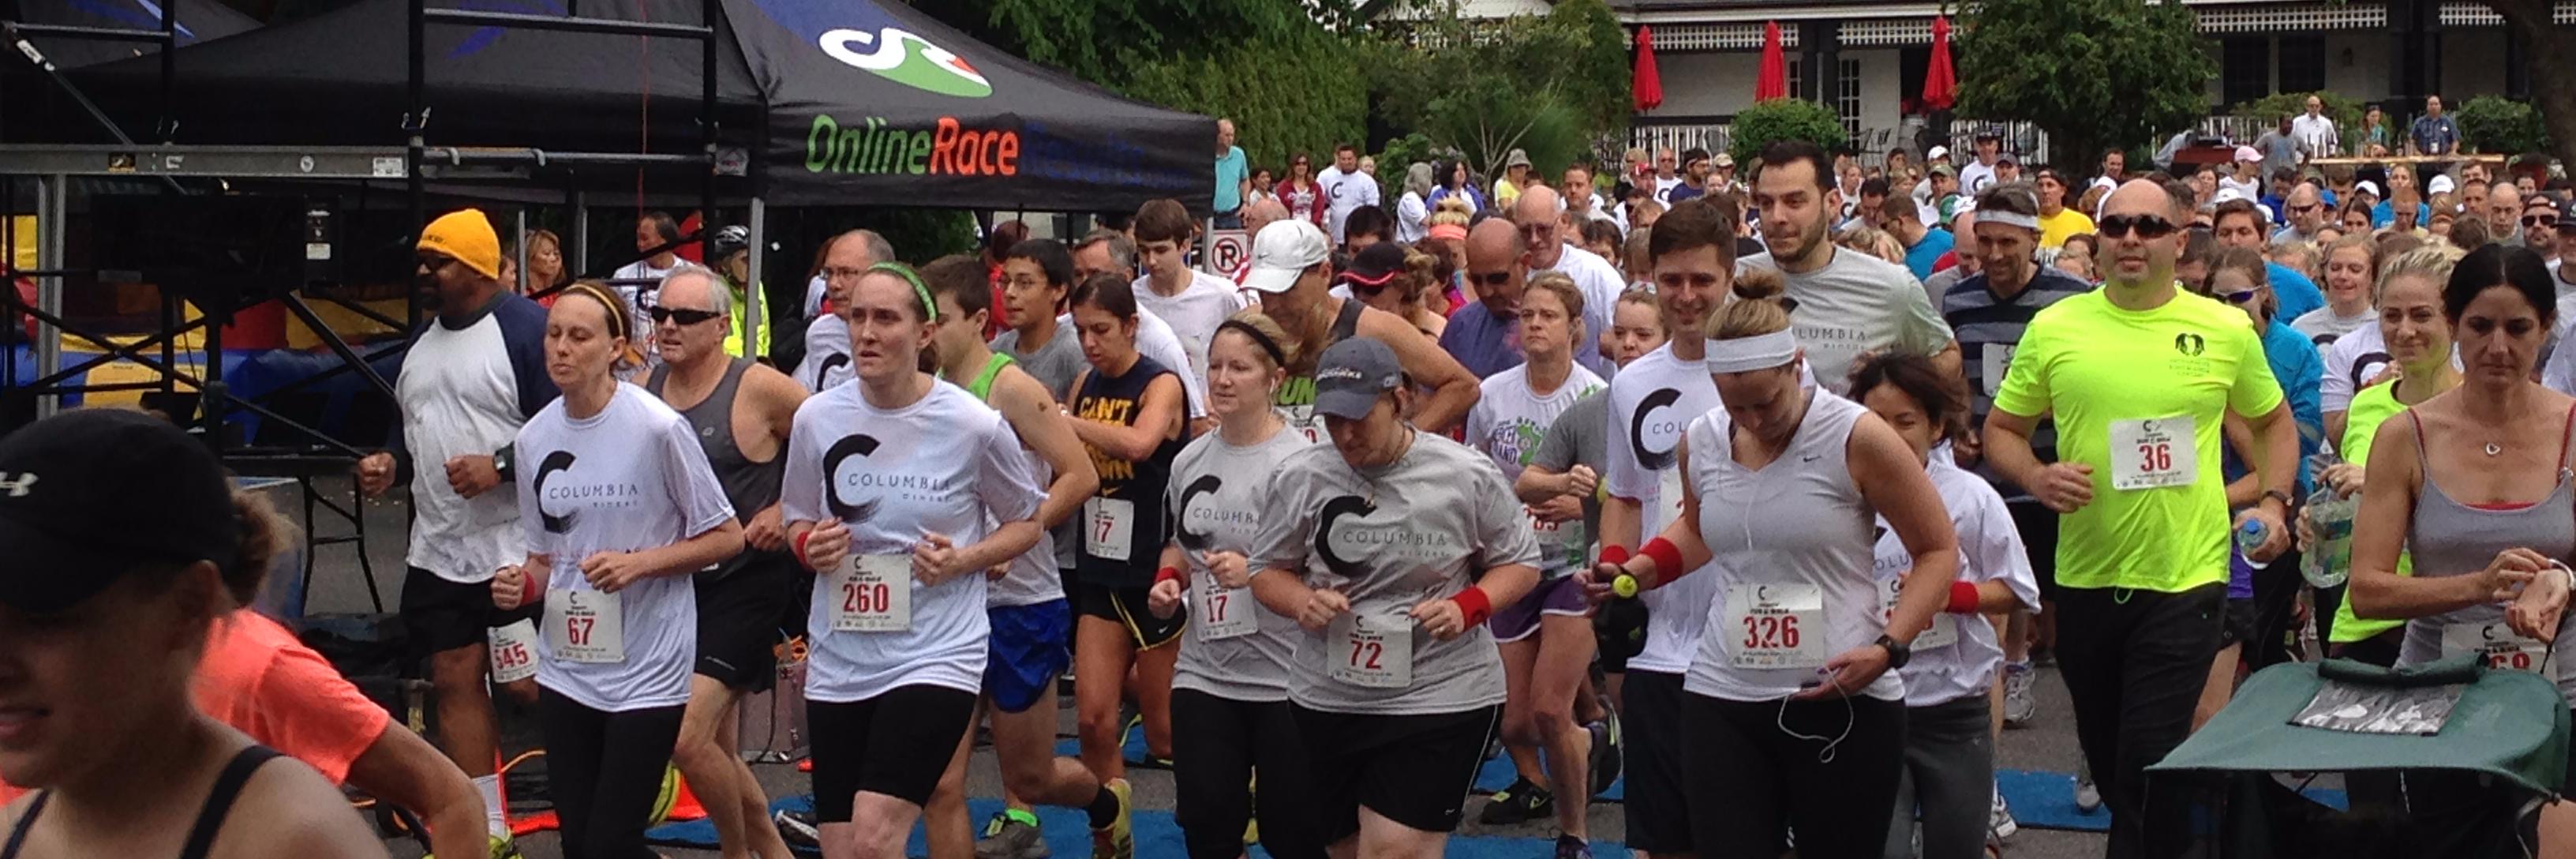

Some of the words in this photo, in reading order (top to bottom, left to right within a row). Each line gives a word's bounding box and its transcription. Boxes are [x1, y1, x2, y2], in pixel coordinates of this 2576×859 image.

[1792, 328, 1866, 340] LUMBIA
[1277, 375, 1316, 406] UN
[2139, 444, 2171, 472] 36
[549, 484, 638, 499] COLUMBIA
[1344, 531, 1446, 546] COLUMBIA
[843, 583, 889, 613] 260
[1207, 595, 1227, 622] 17
[567, 617, 594, 645] 67
[1743, 616, 1799, 648] 326
[1351, 640, 1382, 670] 72
